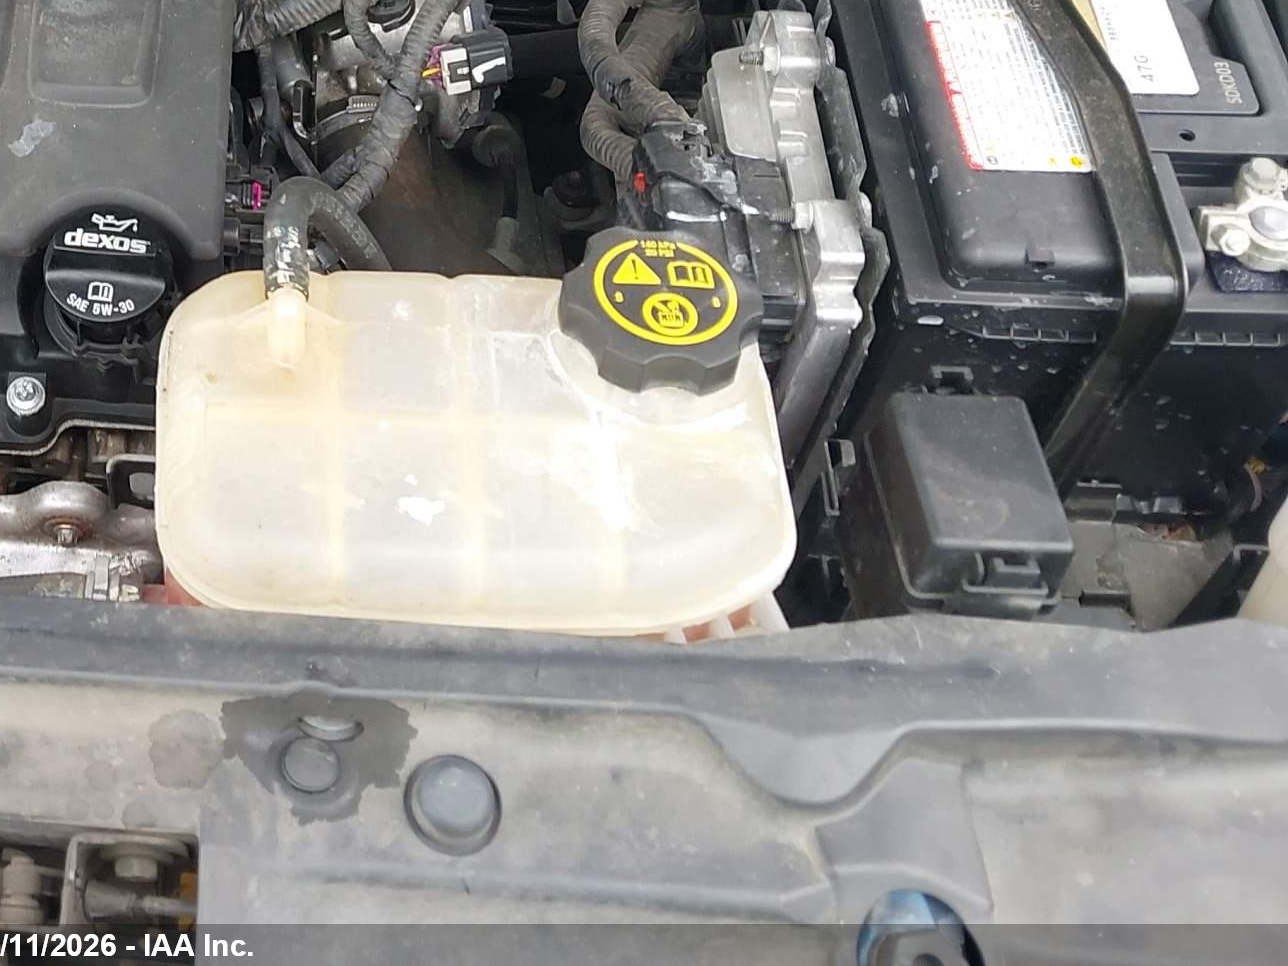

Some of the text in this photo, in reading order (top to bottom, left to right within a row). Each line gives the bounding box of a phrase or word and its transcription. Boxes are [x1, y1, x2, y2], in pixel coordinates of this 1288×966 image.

[64, 228, 148, 253] dexos
[66, 293, 135, 316] SAE 5W-30
